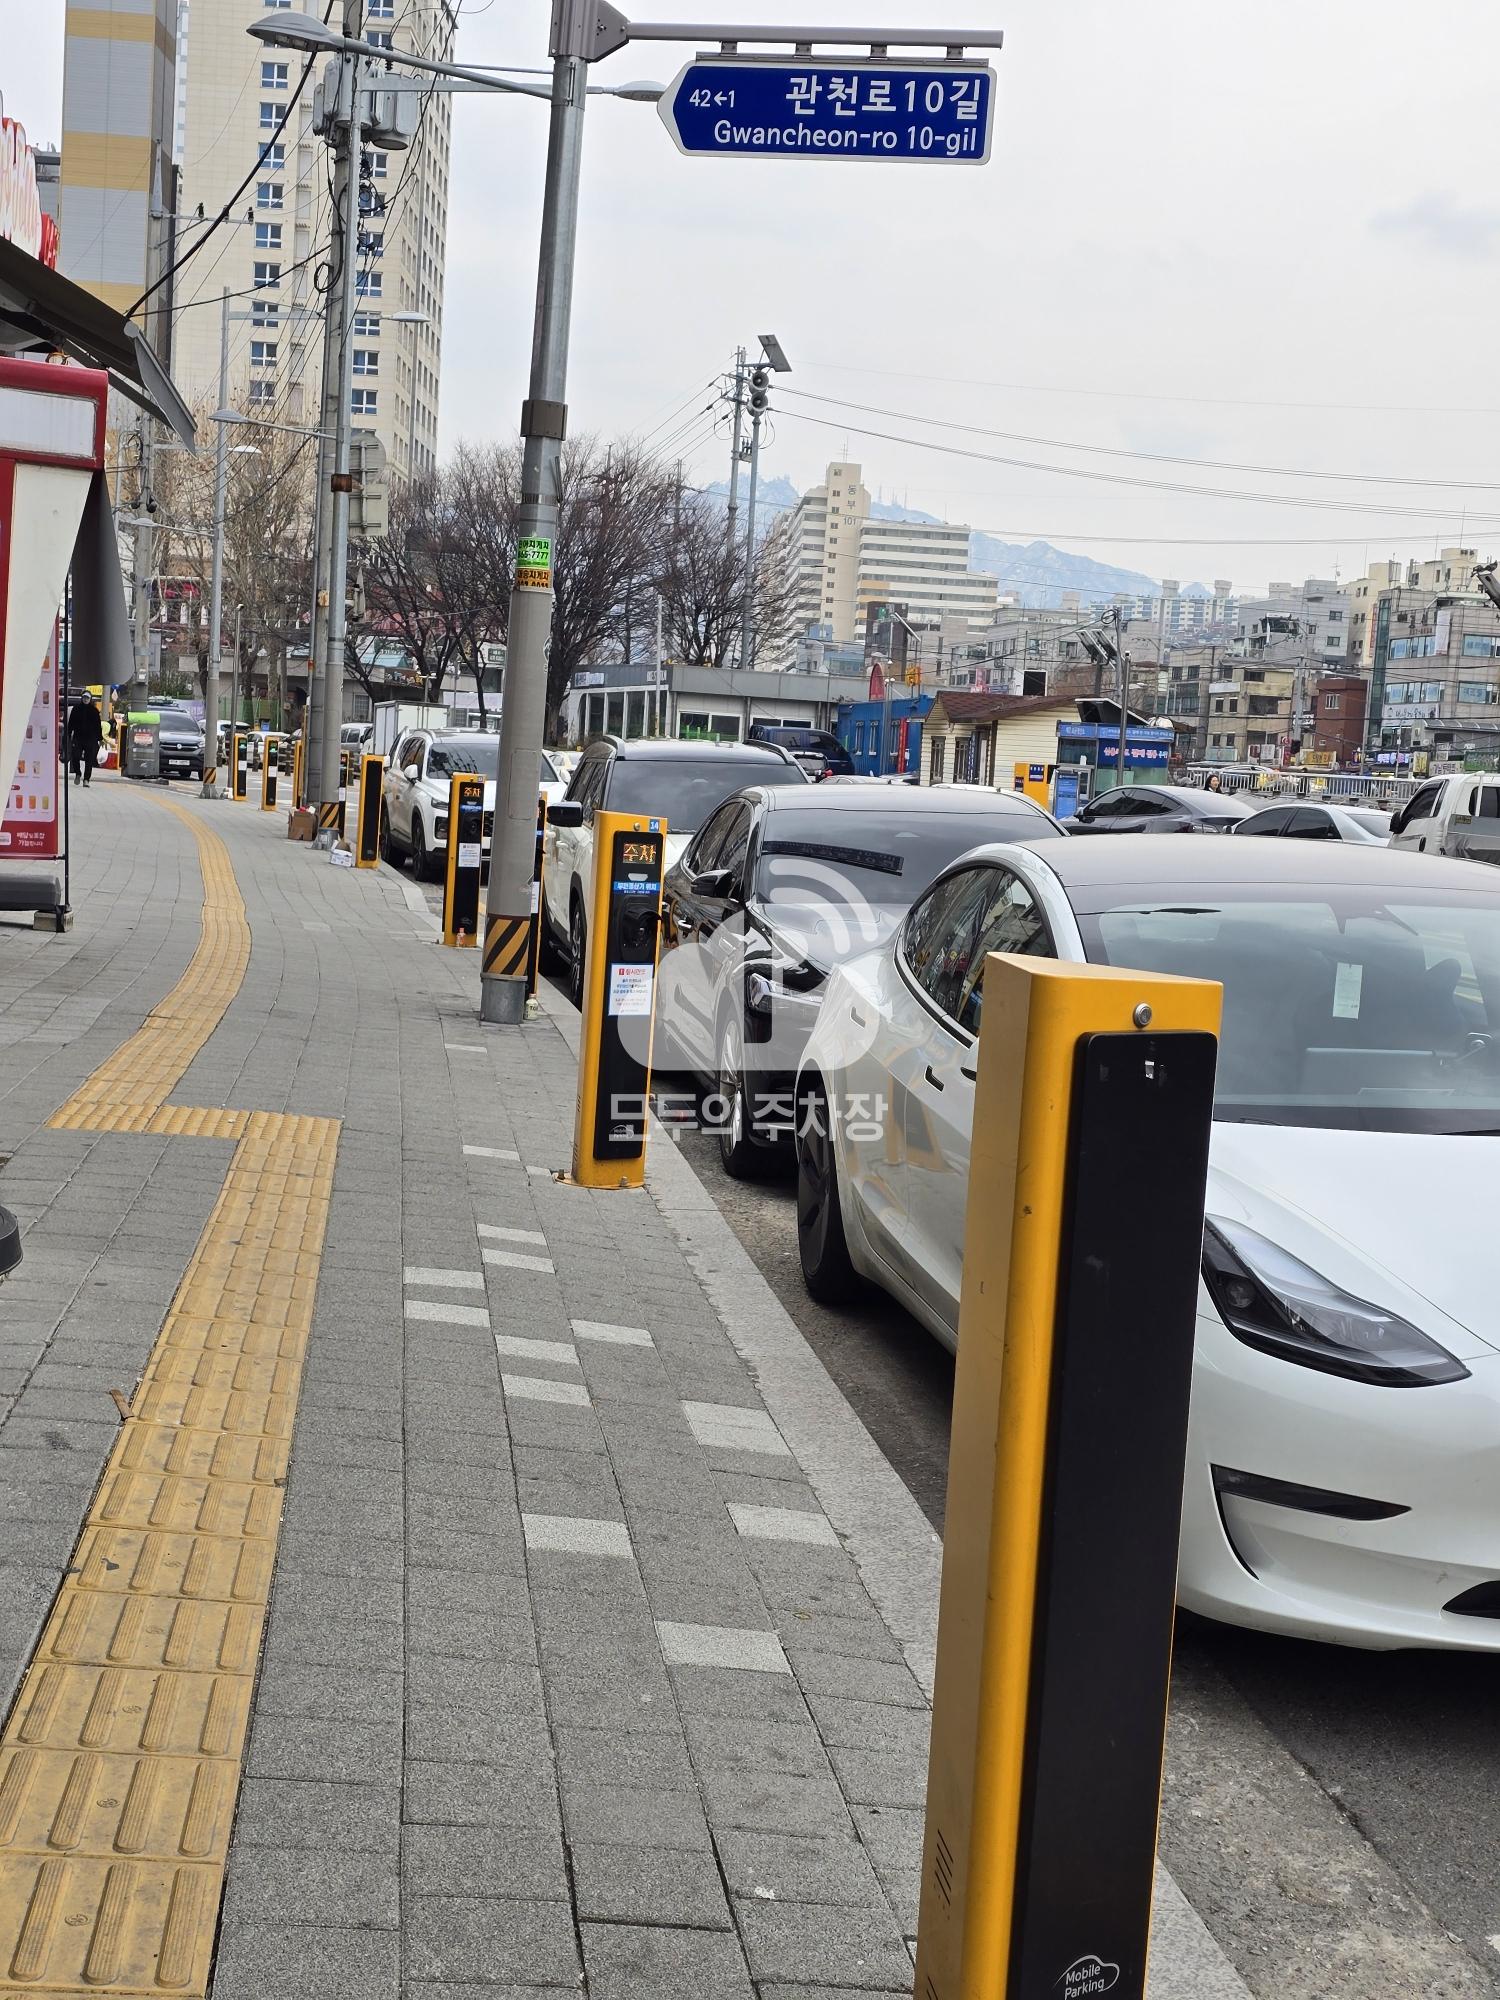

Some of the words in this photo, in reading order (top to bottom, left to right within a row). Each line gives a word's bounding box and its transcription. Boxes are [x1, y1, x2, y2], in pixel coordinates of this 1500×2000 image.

[785, 75, 980, 121] 관천로10길
[714, 119, 898, 149] Gwancheon-ro
[907, 125, 977, 157] 10-gil
[844, 516, 856, 525] 101
[650, 821, 659, 830] 14
[1065, 1964, 1101, 1985] Mobile
[1064, 1978, 1105, 2000] Parking
